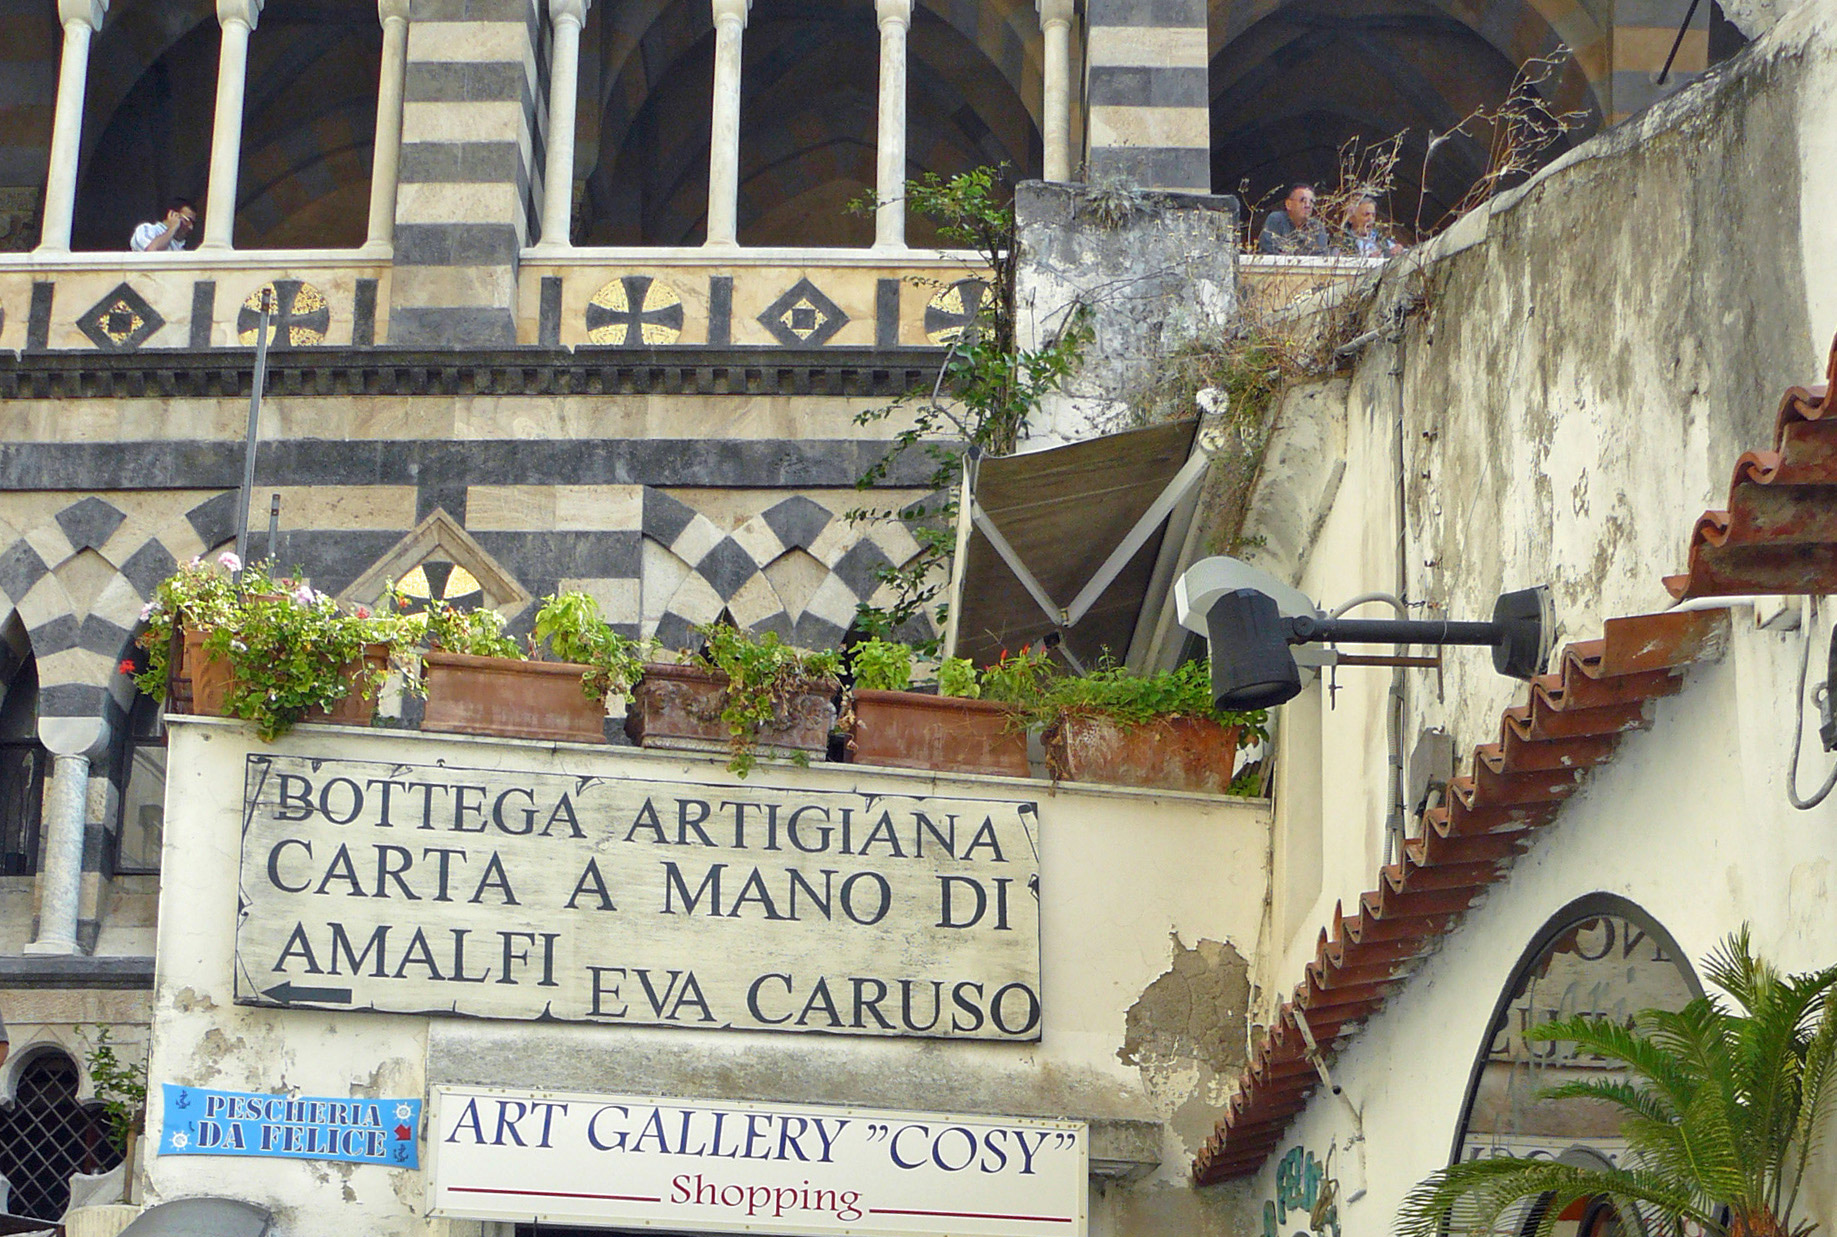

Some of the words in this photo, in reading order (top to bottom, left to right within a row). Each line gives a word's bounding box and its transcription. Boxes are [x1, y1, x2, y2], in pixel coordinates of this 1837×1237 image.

[273, 773, 588, 839] BOTTEGA
[622, 797, 1009, 863] ARTIGIANA
[267, 839, 522, 905] CARTA
[563, 856, 618, 912] A
[660, 861, 892, 926] MANO
[935, 875, 1013, 931] DI
[271, 921, 561, 986] AMALFI
[585, 966, 718, 1023] EVA
[747, 973, 1041, 1036] CARUSO
[197, 1121, 247, 1149] DA
[260, 1124, 388, 1158] FELICE
[205, 1095, 382, 1128] PESCHERIA
[444, 1097, 569, 1149] ART
[588, 1105, 852, 1163] GALLERY
[670, 1173, 863, 1222] Shopping
